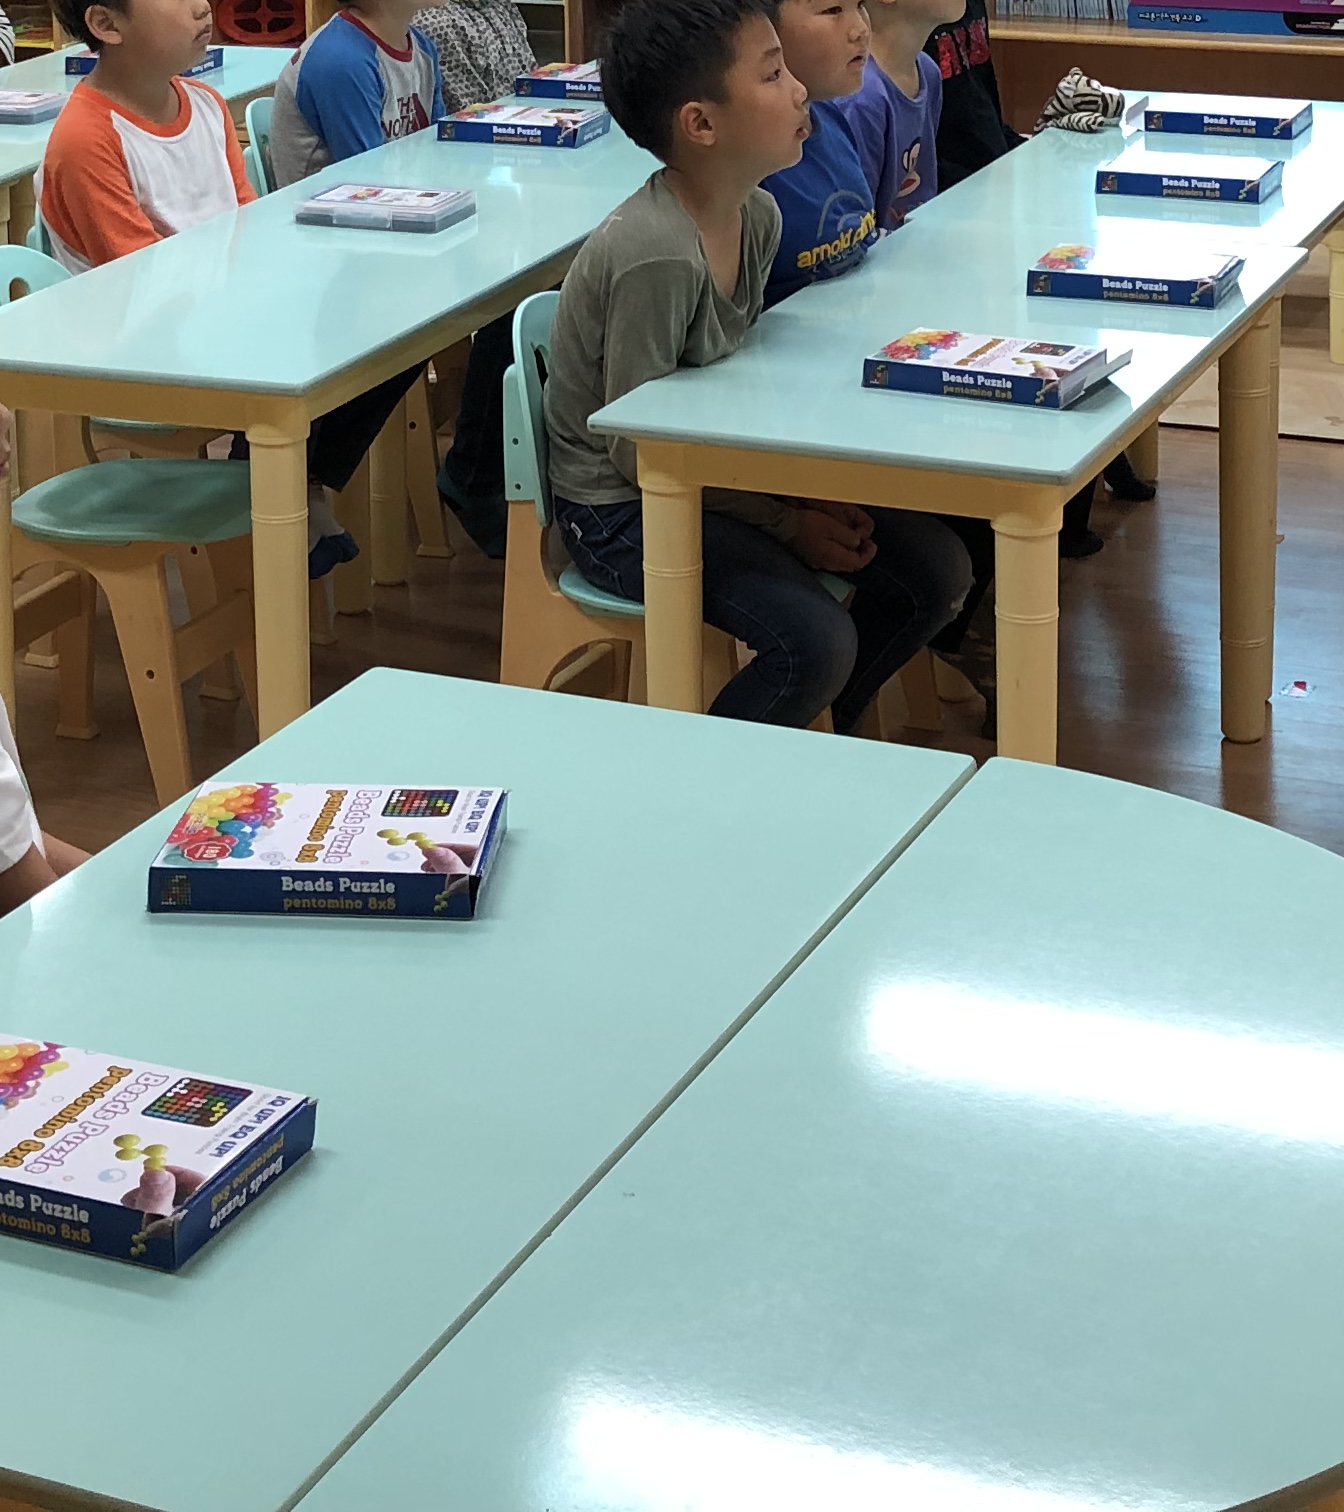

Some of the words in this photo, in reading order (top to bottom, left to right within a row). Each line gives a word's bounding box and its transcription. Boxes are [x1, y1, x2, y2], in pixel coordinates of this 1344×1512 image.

[796, 227, 853, 269] arnold
[1102, 279, 1132, 290] Beads
[1135, 281, 1169, 292] Puzzle
[942, 371, 974, 385] Beads
[977, 375, 1012, 389] Puzzle
[306, 789, 348, 842] pentomino
[343, 789, 382, 824] Beads
[322, 825, 366, 864] Puzzle
[281, 876, 333, 893] Beads
[339, 877, 395, 894] Puzzle
[283, 895, 362, 912] pentomino
[34, 1065, 133, 1139] pentomino
[93, 1071, 170, 1120] Beads
[267, 1095, 292, 1107] IQ
[229, 1124, 258, 1139] EQ
[248, 1107, 276, 1125] UP!
[24, 1121, 109, 1174] Puzzle
[209, 1141, 238, 1158] UP!
[250, 1155, 284, 1194] Beads
[29, 1193, 89, 1224] Puzzle
[209, 1187, 247, 1229] Puzzle
[60, 1224, 92, 1246] 8x8
